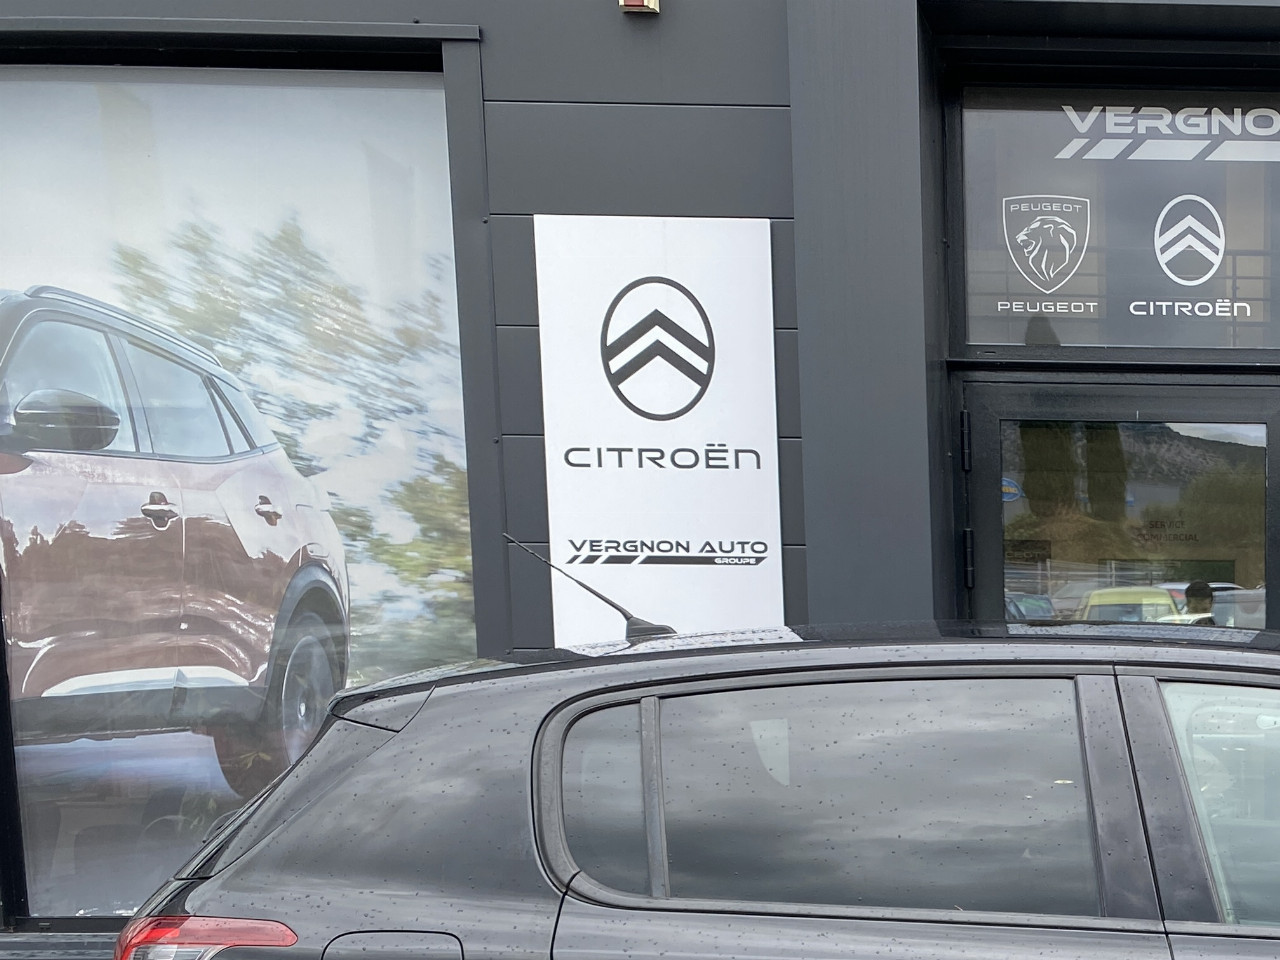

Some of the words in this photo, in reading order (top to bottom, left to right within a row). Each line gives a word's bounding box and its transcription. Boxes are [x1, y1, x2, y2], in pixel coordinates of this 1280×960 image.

[1010, 201, 1083, 213] PEUGEOT
[997, 301, 1098, 313] PEUGEOT
[568, 539, 690, 553] VERGNON
[698, 541, 768, 554] AUTO
[714, 557, 757, 565] GROUPE
